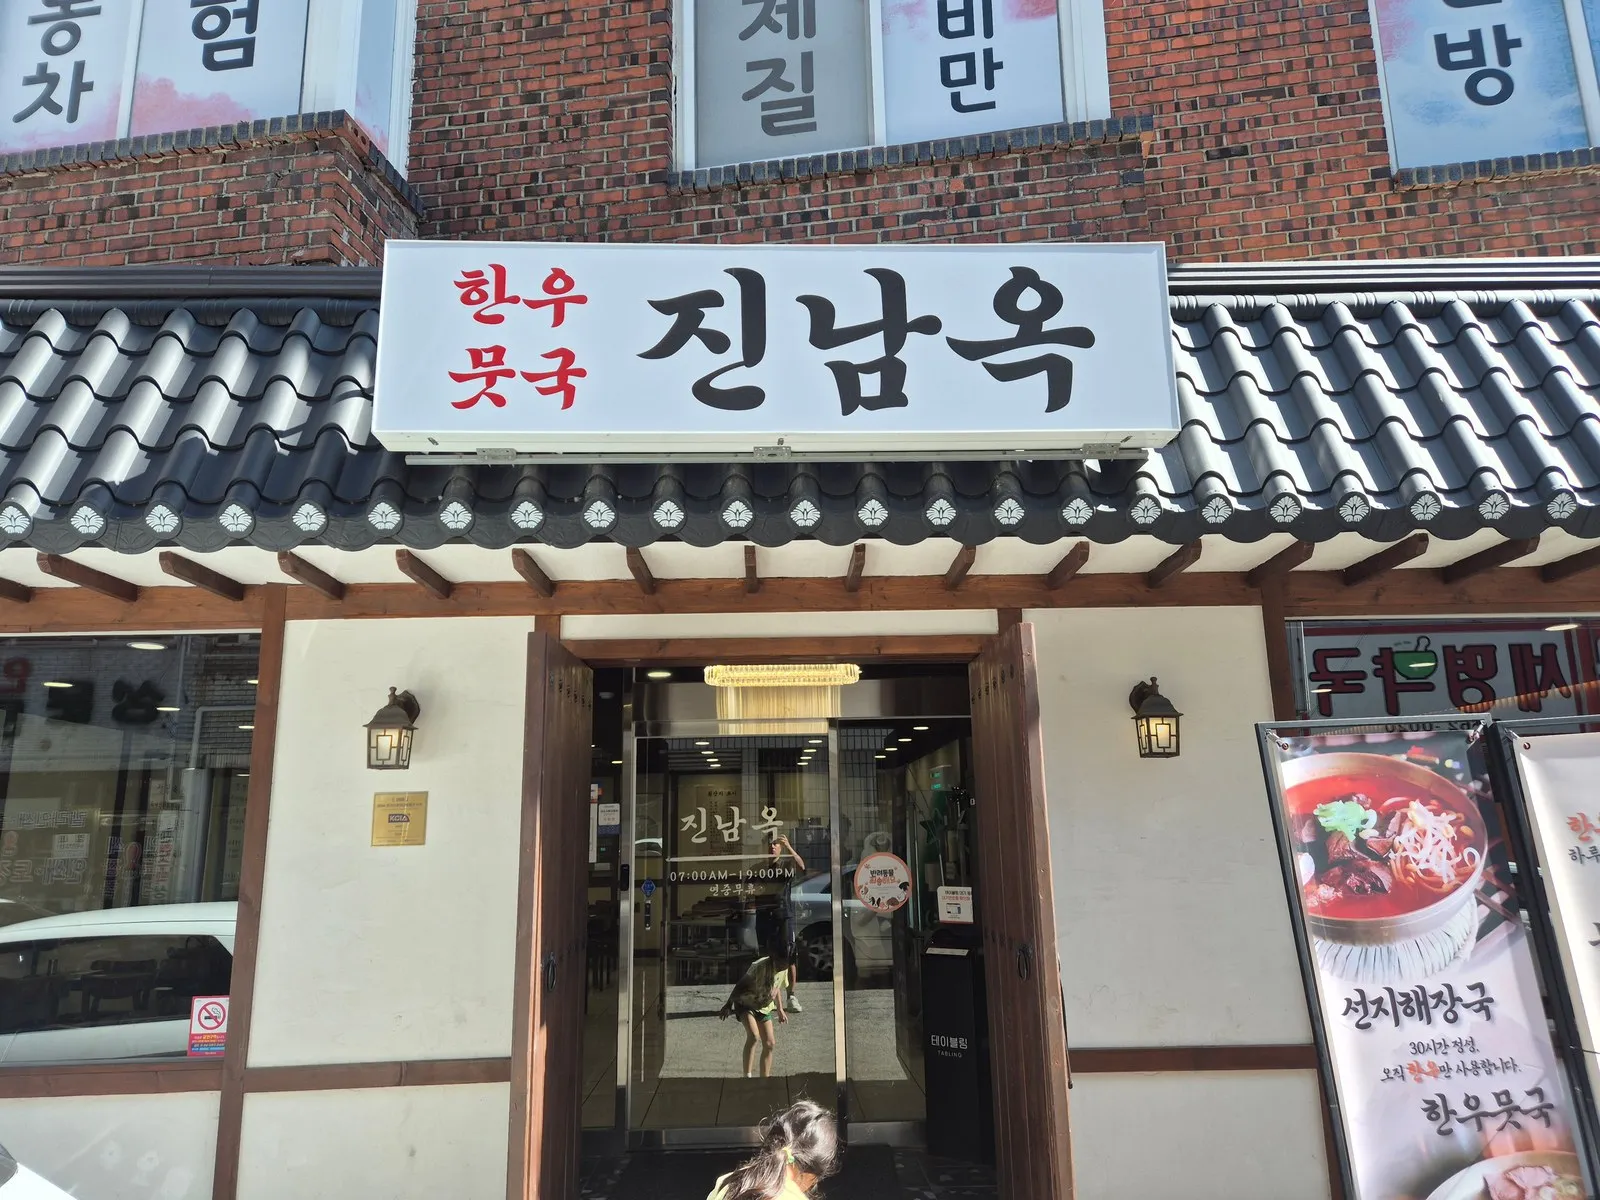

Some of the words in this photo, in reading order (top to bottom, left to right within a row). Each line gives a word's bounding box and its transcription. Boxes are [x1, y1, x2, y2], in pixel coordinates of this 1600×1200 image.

[452, 264, 588, 328] 한우
[636, 266, 1096, 417] 진남옥
[448, 344, 588, 411] 뭇국
[680, 805, 784, 844] 진남옥
[670, 867, 795, 882] 07:00AM-19:00PM
[709, 883, 756, 897] 연중무휴
[1341, 981, 1495, 1030] 선지해장국
[930, 1034, 968, 1050] 테이블링
[1409, 1038, 1450, 1056] 30시간
[1380, 1064, 1405, 1082] 오직
[1405, 1059, 1453, 1083] 한우만
[1420, 1087, 1555, 1136] 한우뭇국
